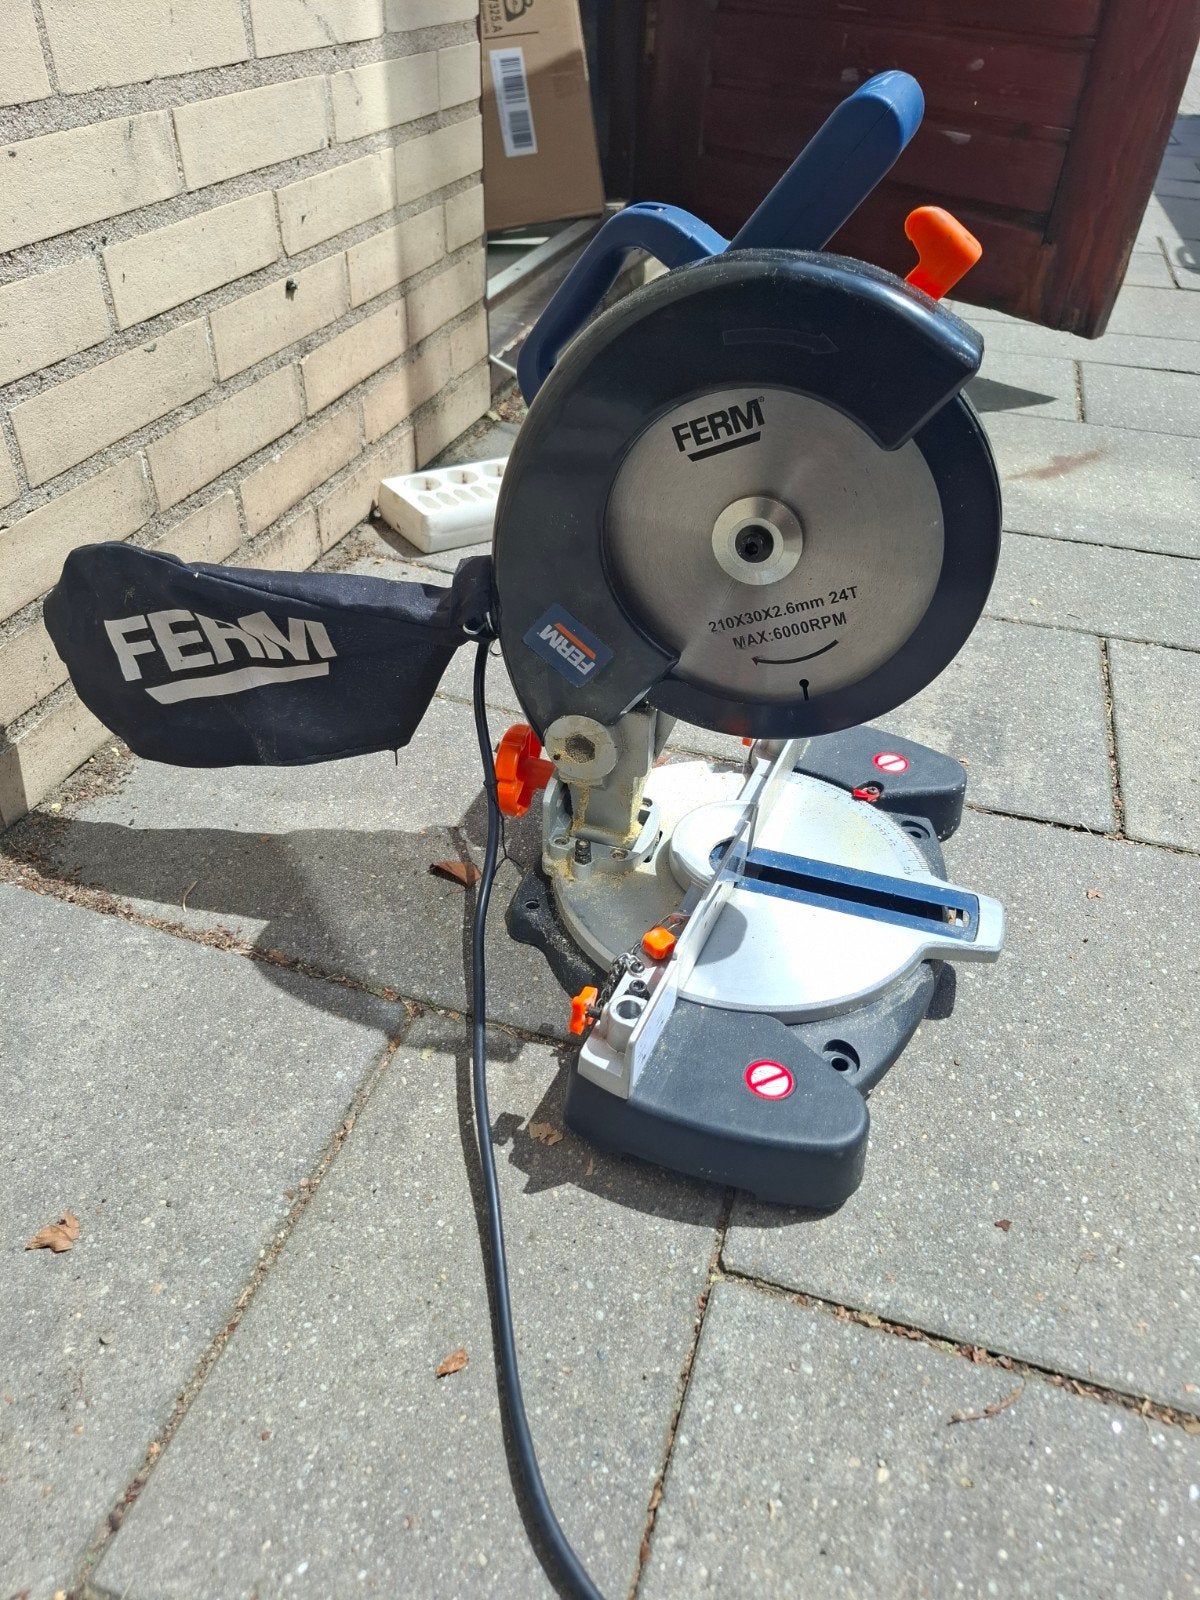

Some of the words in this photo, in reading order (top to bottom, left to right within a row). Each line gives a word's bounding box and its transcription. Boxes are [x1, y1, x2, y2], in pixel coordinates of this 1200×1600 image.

[708, 597, 825, 633] 210X30X2.6mm
[828, 586, 858, 605] 24T
[732, 611, 848, 650] MAX:6000RPM
[103, 609, 338, 682] FERM
[539, 624, 596, 676] FERM
